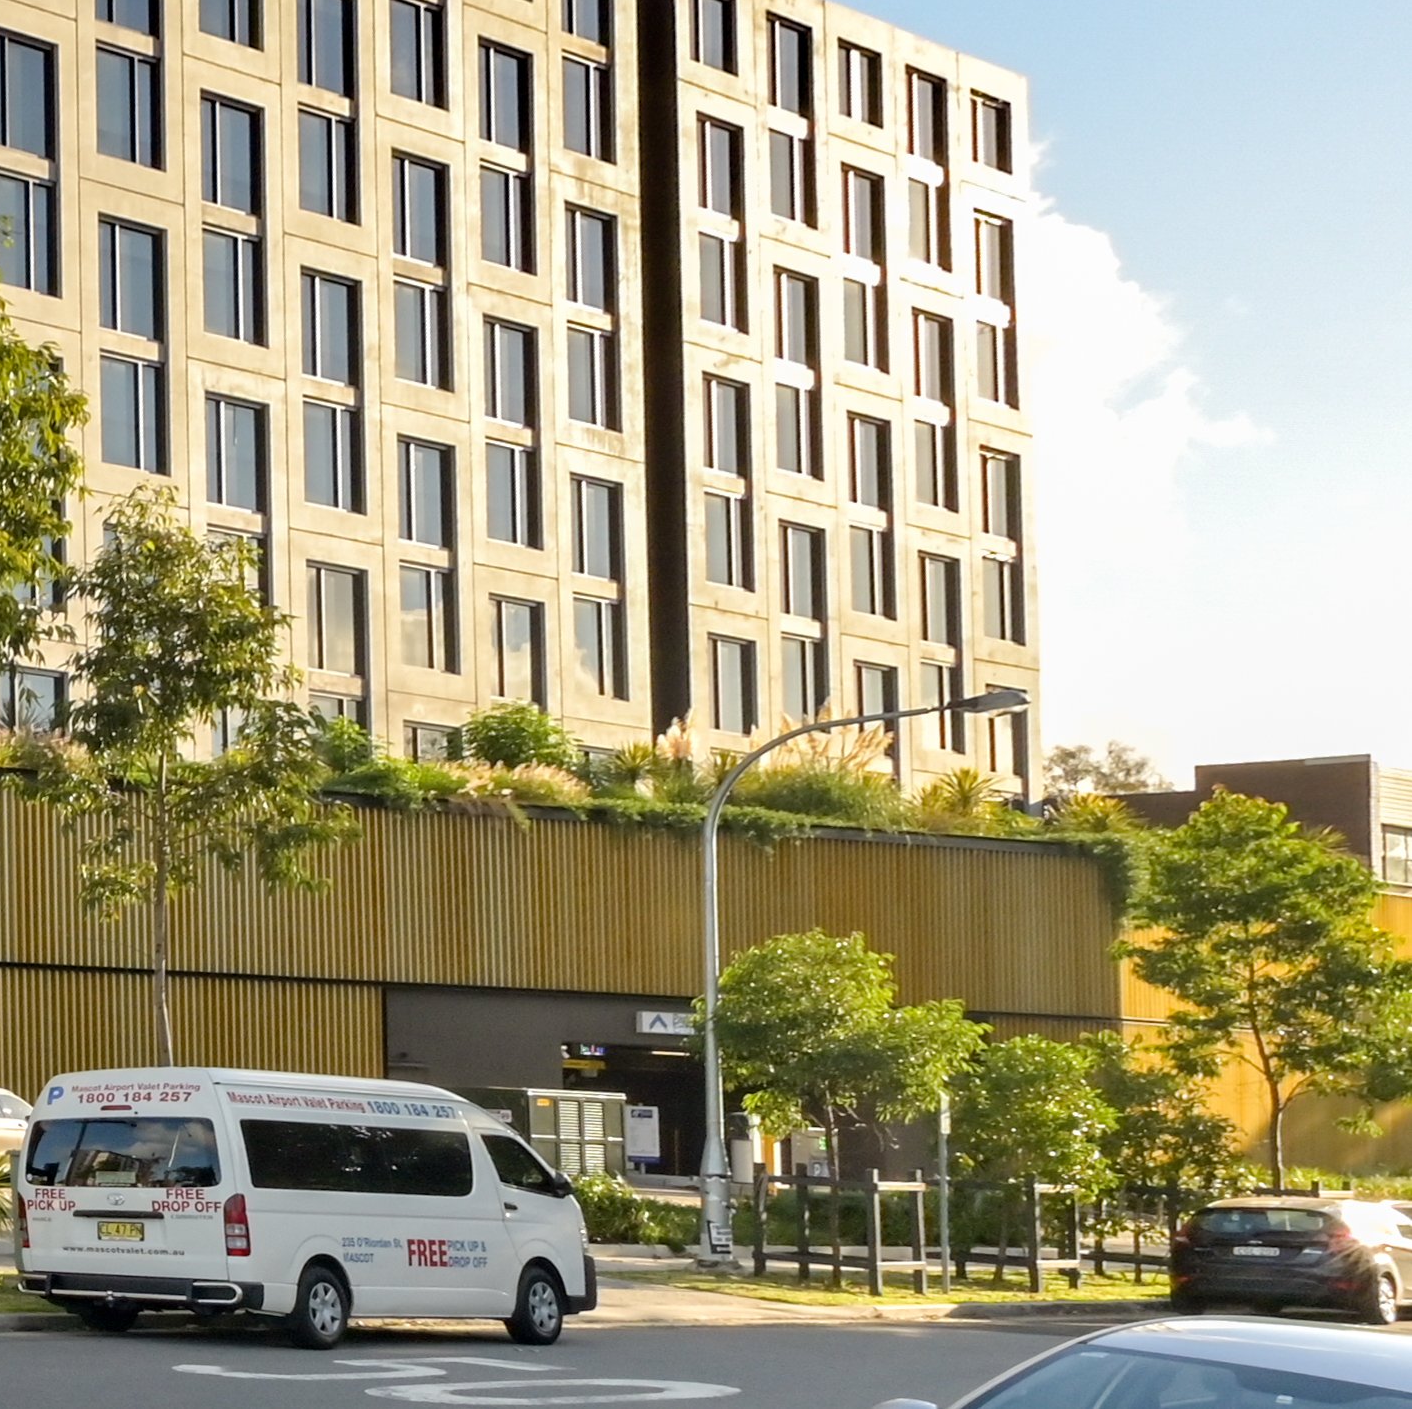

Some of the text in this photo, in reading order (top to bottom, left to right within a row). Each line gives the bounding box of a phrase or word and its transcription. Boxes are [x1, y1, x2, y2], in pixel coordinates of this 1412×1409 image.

[71, 1082, 200, 1093] Mascot Airport Valet Parking
[47, 1086, 64, 1105] P
[78, 1091, 192, 1104] 1800 184 257
[227, 1091, 457, 1119] Mascot Airport Valet Parking 1800 184 257
[35, 1188, 65, 1200] FREE
[166, 1188, 205, 1200] FREE
[27, 1200, 76, 1211] PICK UP
[152, 1200, 222, 1213] DROP OFF
[62, 1244, 185, 1256] www.mascotvalet.com.au
[448, 1240, 466, 1252] PICK
[467, 1241, 480, 1252] UP
[343, 1252, 374, 1263] MASCOT
[407, 1238, 449, 1267] FREE
[449, 1256, 488, 1268] DROP OFF
